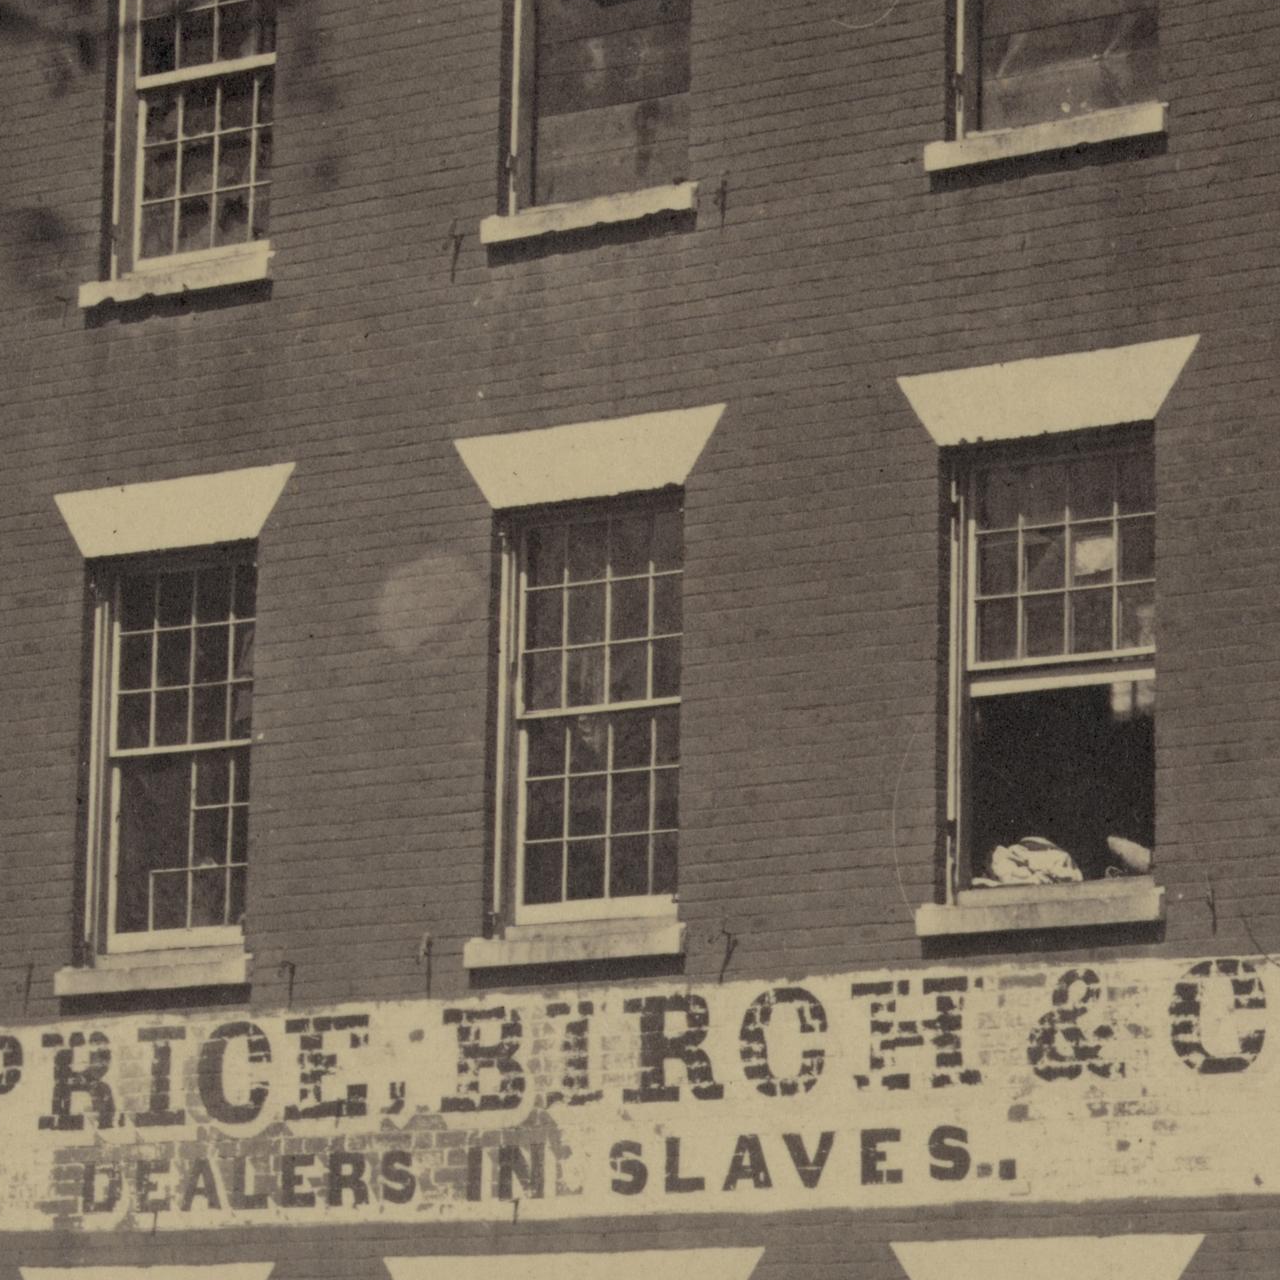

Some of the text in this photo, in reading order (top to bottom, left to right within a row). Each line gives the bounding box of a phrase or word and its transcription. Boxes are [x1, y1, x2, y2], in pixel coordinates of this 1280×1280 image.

[440, 976, 983, 1113] BIRCH
[1027, 968, 1124, 1083] &
[81, 1149, 417, 1214] DEALERS
[466, 1142, 545, 1202] IN
